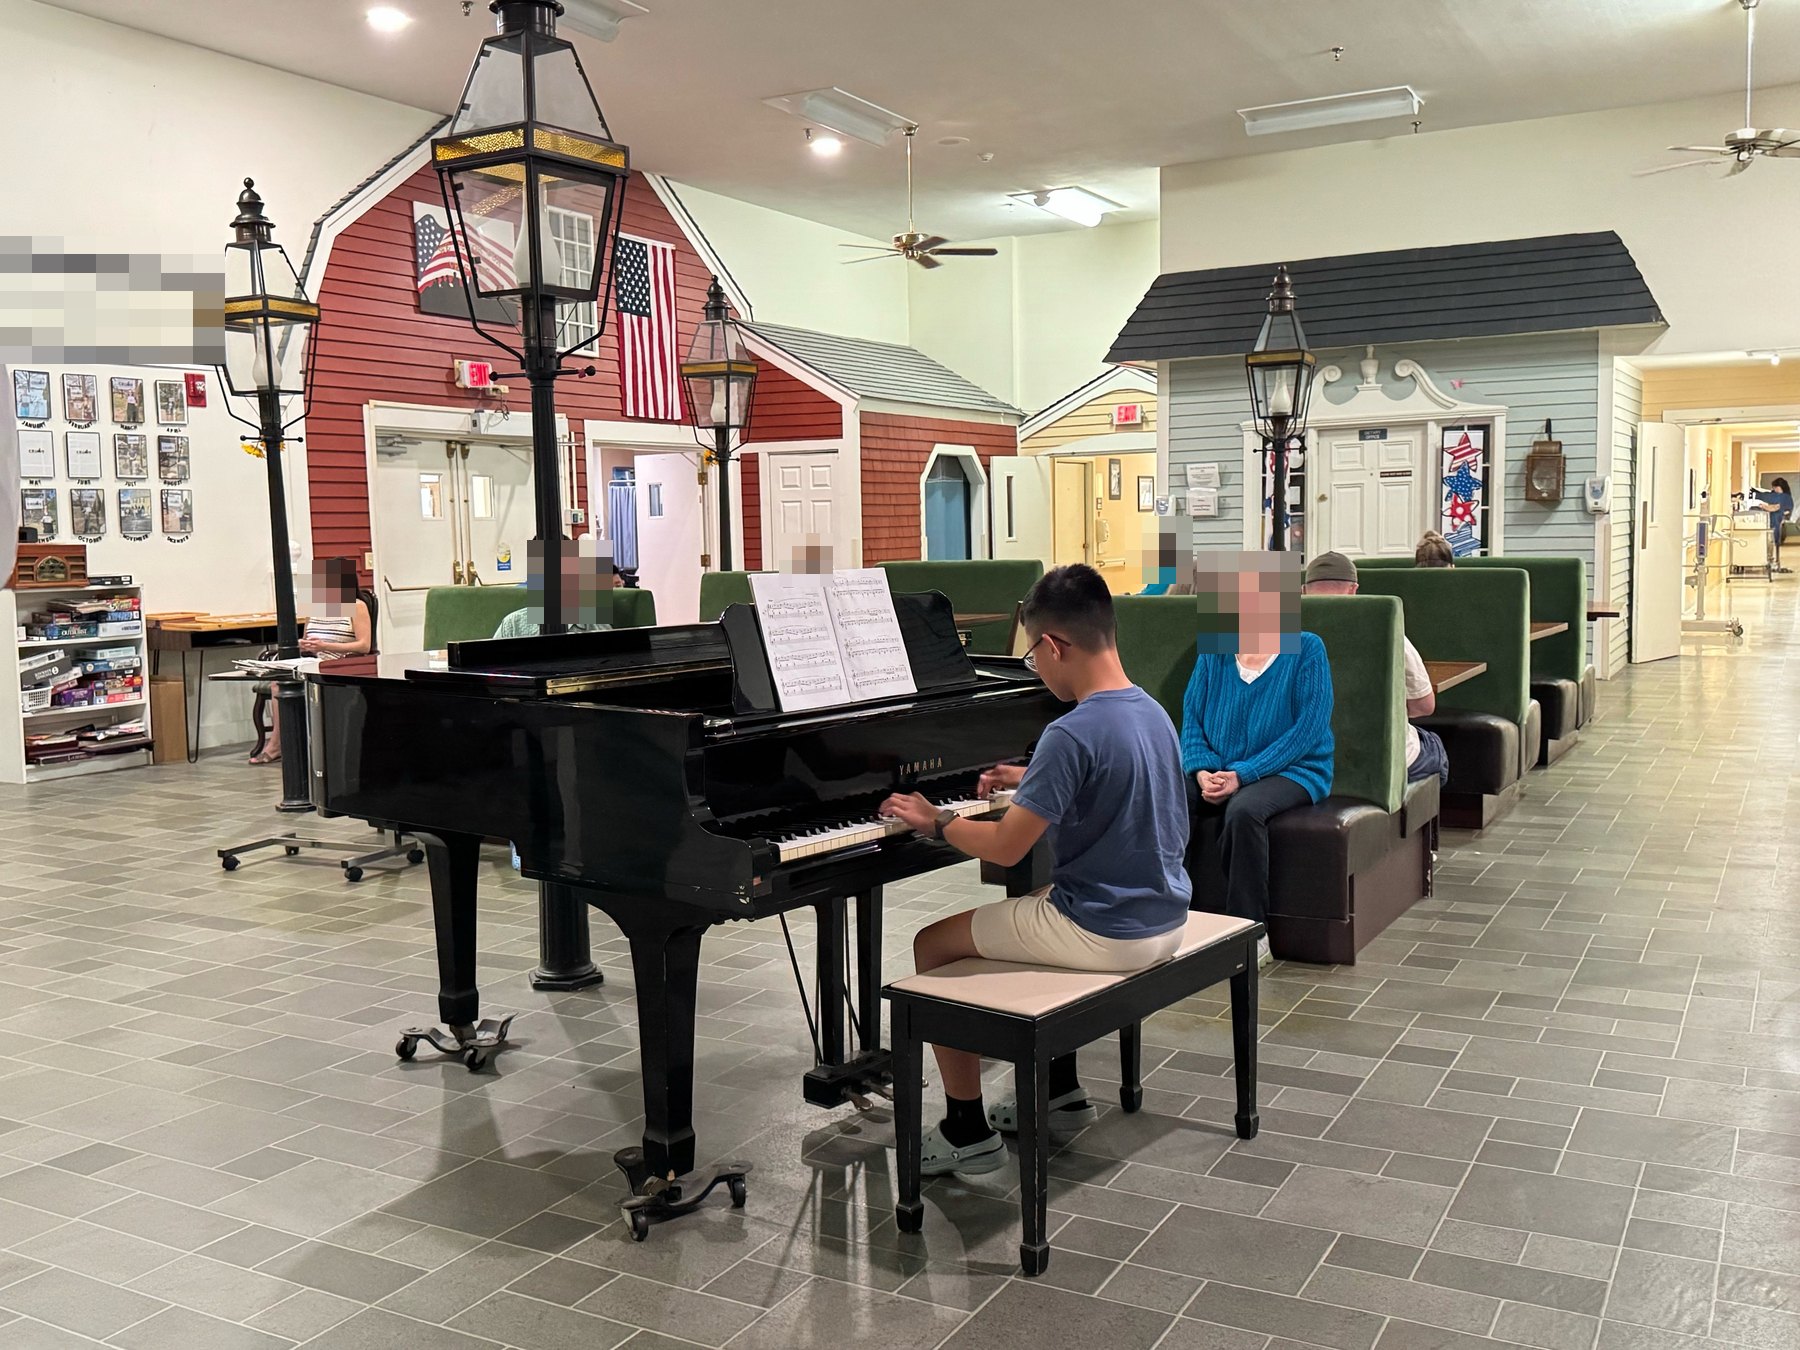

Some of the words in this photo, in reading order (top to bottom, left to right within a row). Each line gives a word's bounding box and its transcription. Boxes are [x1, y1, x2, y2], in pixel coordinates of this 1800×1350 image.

[77, 535, 103, 543] OCTOBER
[122, 534, 149, 542] NOVEMBER
[899, 757, 943, 776] YAMAHA
